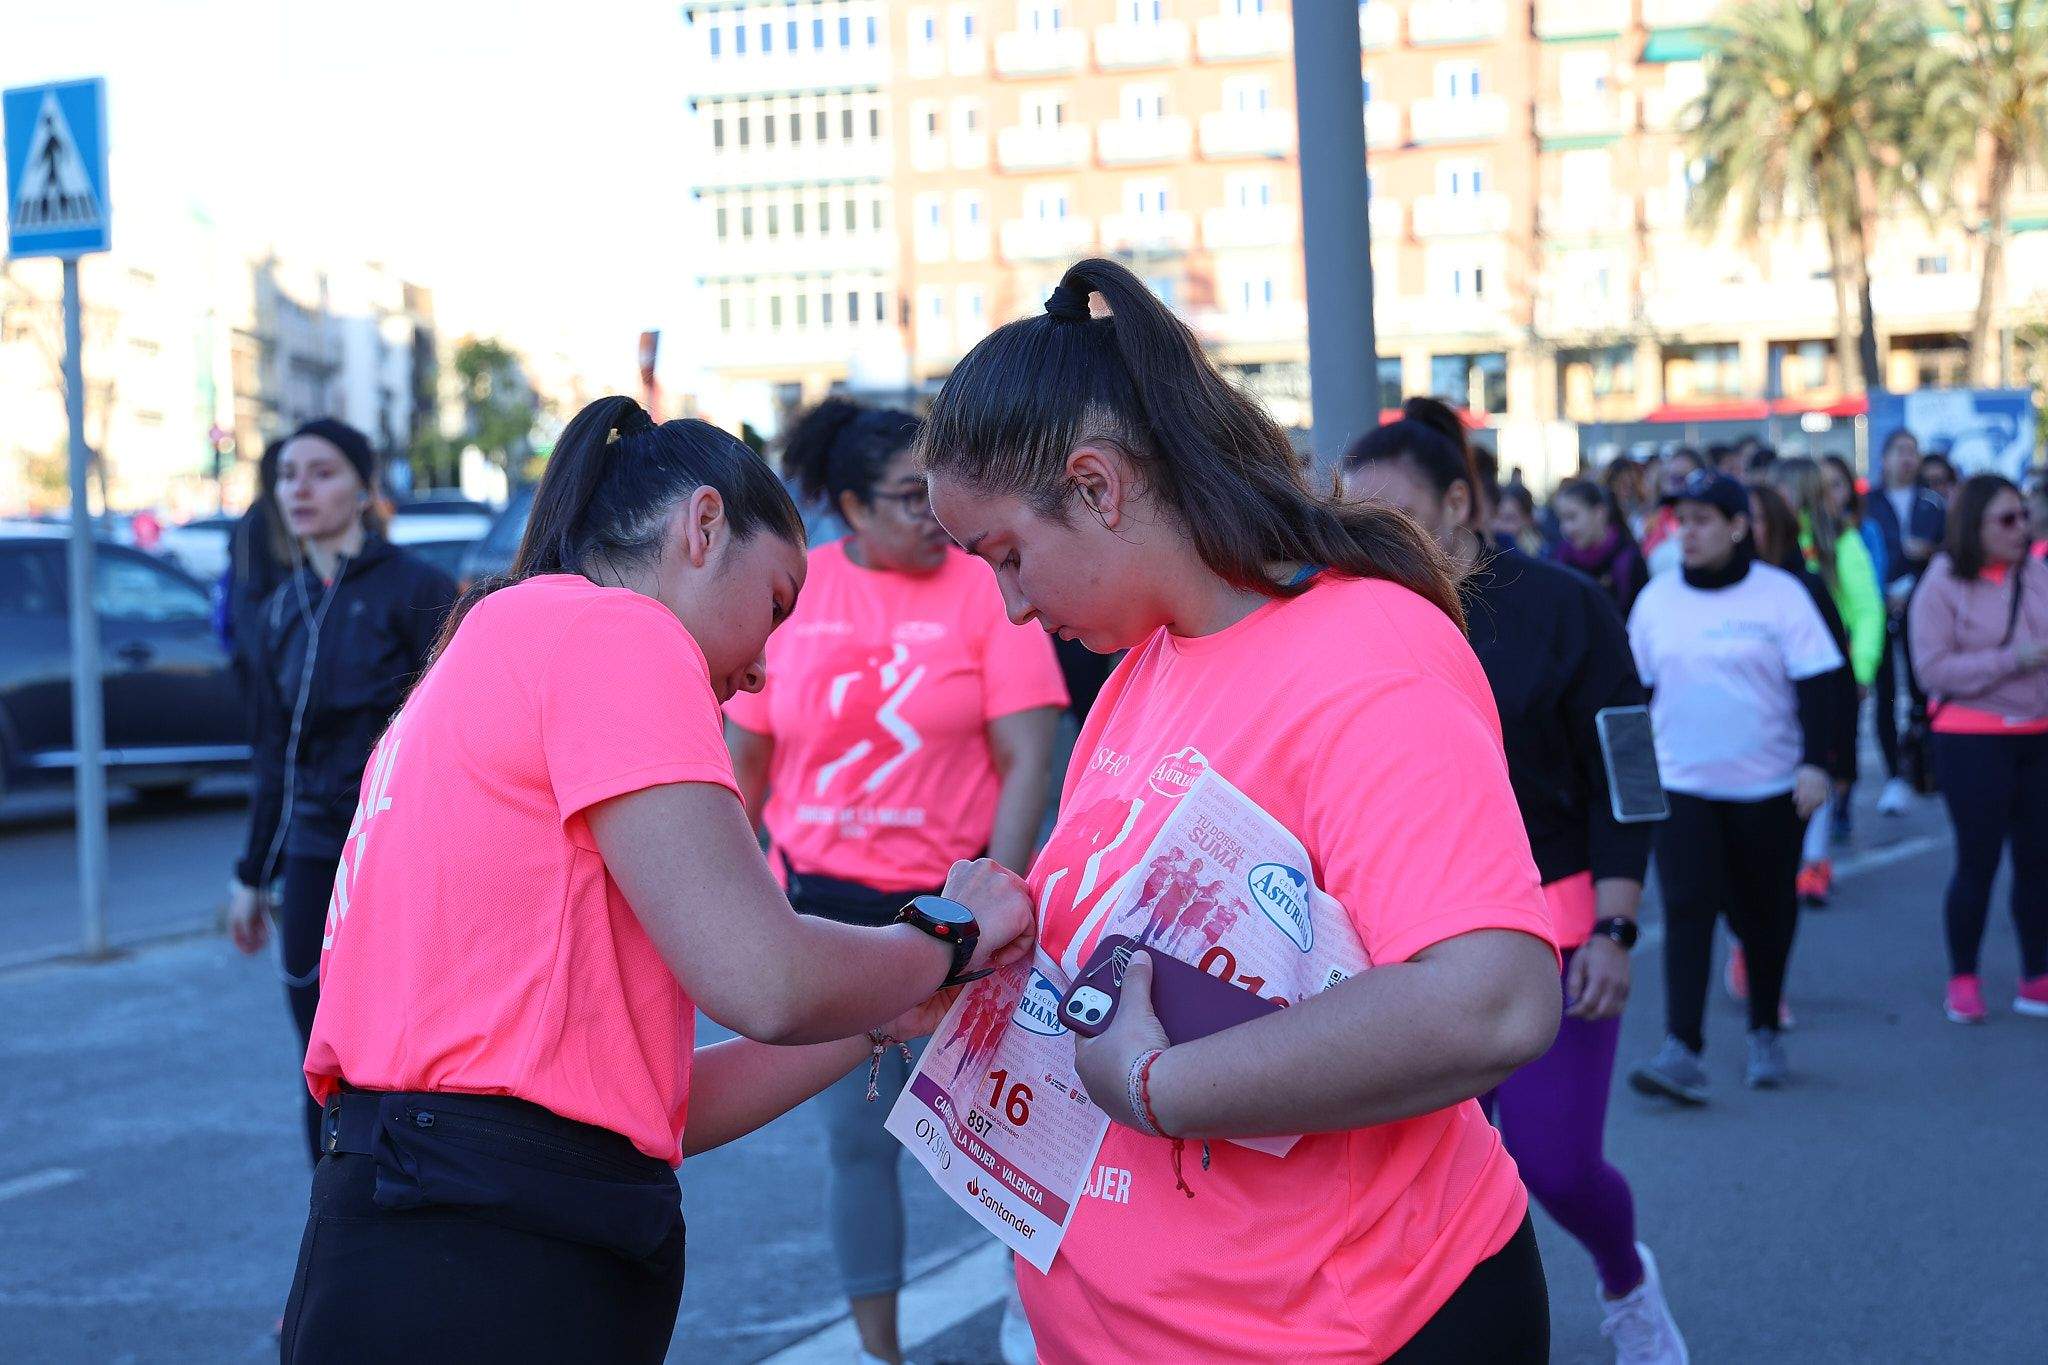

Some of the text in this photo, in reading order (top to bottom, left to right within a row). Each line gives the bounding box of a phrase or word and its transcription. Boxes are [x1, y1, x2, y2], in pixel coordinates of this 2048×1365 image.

[1186, 825, 1241, 873] SUMA
[1195, 814, 1211, 829] TU
[1208, 825, 1247, 859] DORSAL
[1018, 996, 1061, 1032] RIANA
[915, 1118, 951, 1171] OYSHO
[963, 1109, 992, 1137] 897
[934, 1095, 956, 1130] CARA
[957, 1130, 968, 1148] LA
[968, 1139, 997, 1170] MUJER
[1001, 1165, 1044, 1206] VALENCIA
[1082, 1165, 1132, 1204] JER
[979, 1187, 1036, 1240] Santander
